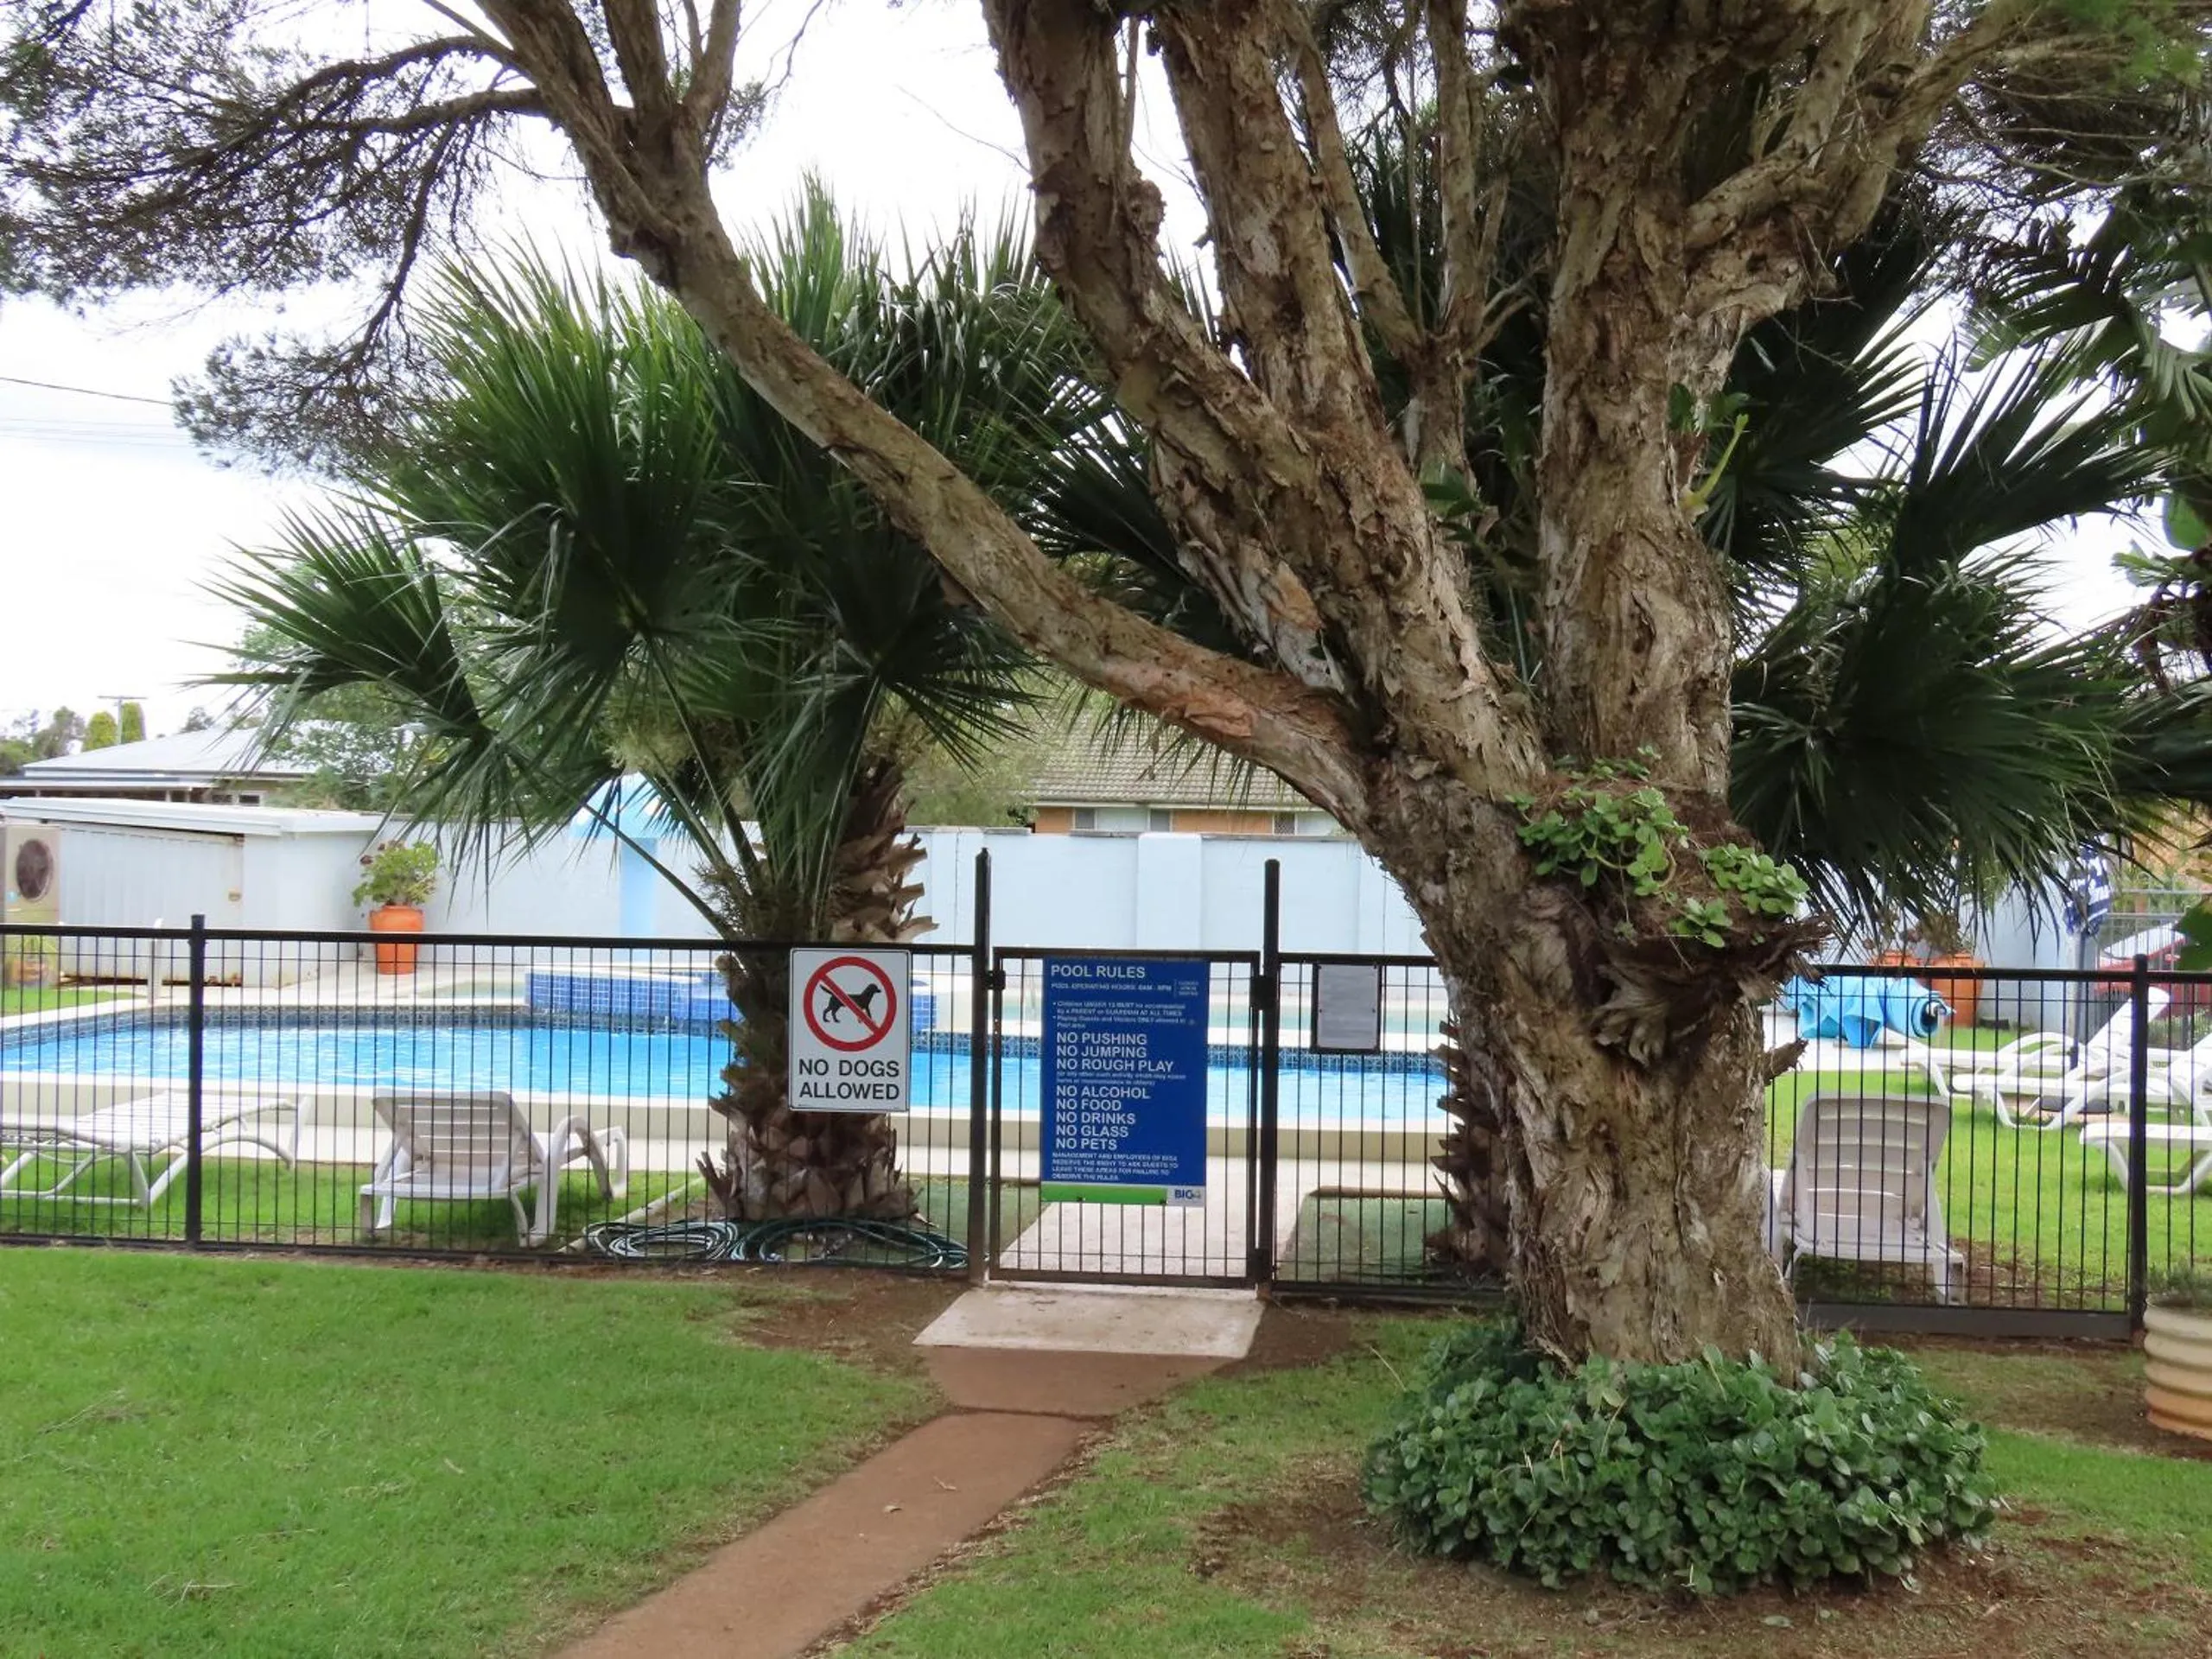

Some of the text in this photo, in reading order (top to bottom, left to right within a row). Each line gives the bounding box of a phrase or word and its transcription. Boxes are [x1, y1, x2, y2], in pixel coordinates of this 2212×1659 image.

[1051, 964, 1146, 979] POOL RULES
[1057, 1033, 1147, 1046] NO PUSHING
[1057, 1046, 1147, 1058] NO JUMPING
[798, 1058, 899, 1077] NO DOGS
[1057, 1058, 1174, 1072] NO ROUGH PLAY
[799, 1082, 899, 1100] ALLOWED
[1056, 1085, 1151, 1099] NO ALCOHOL
[1056, 1098, 1122, 1111] NO FOOD
[1056, 1112, 1136, 1124] NO DRINKS
[1056, 1125, 1129, 1138] NO GLASS
[1056, 1138, 1117, 1151] NO PETS
